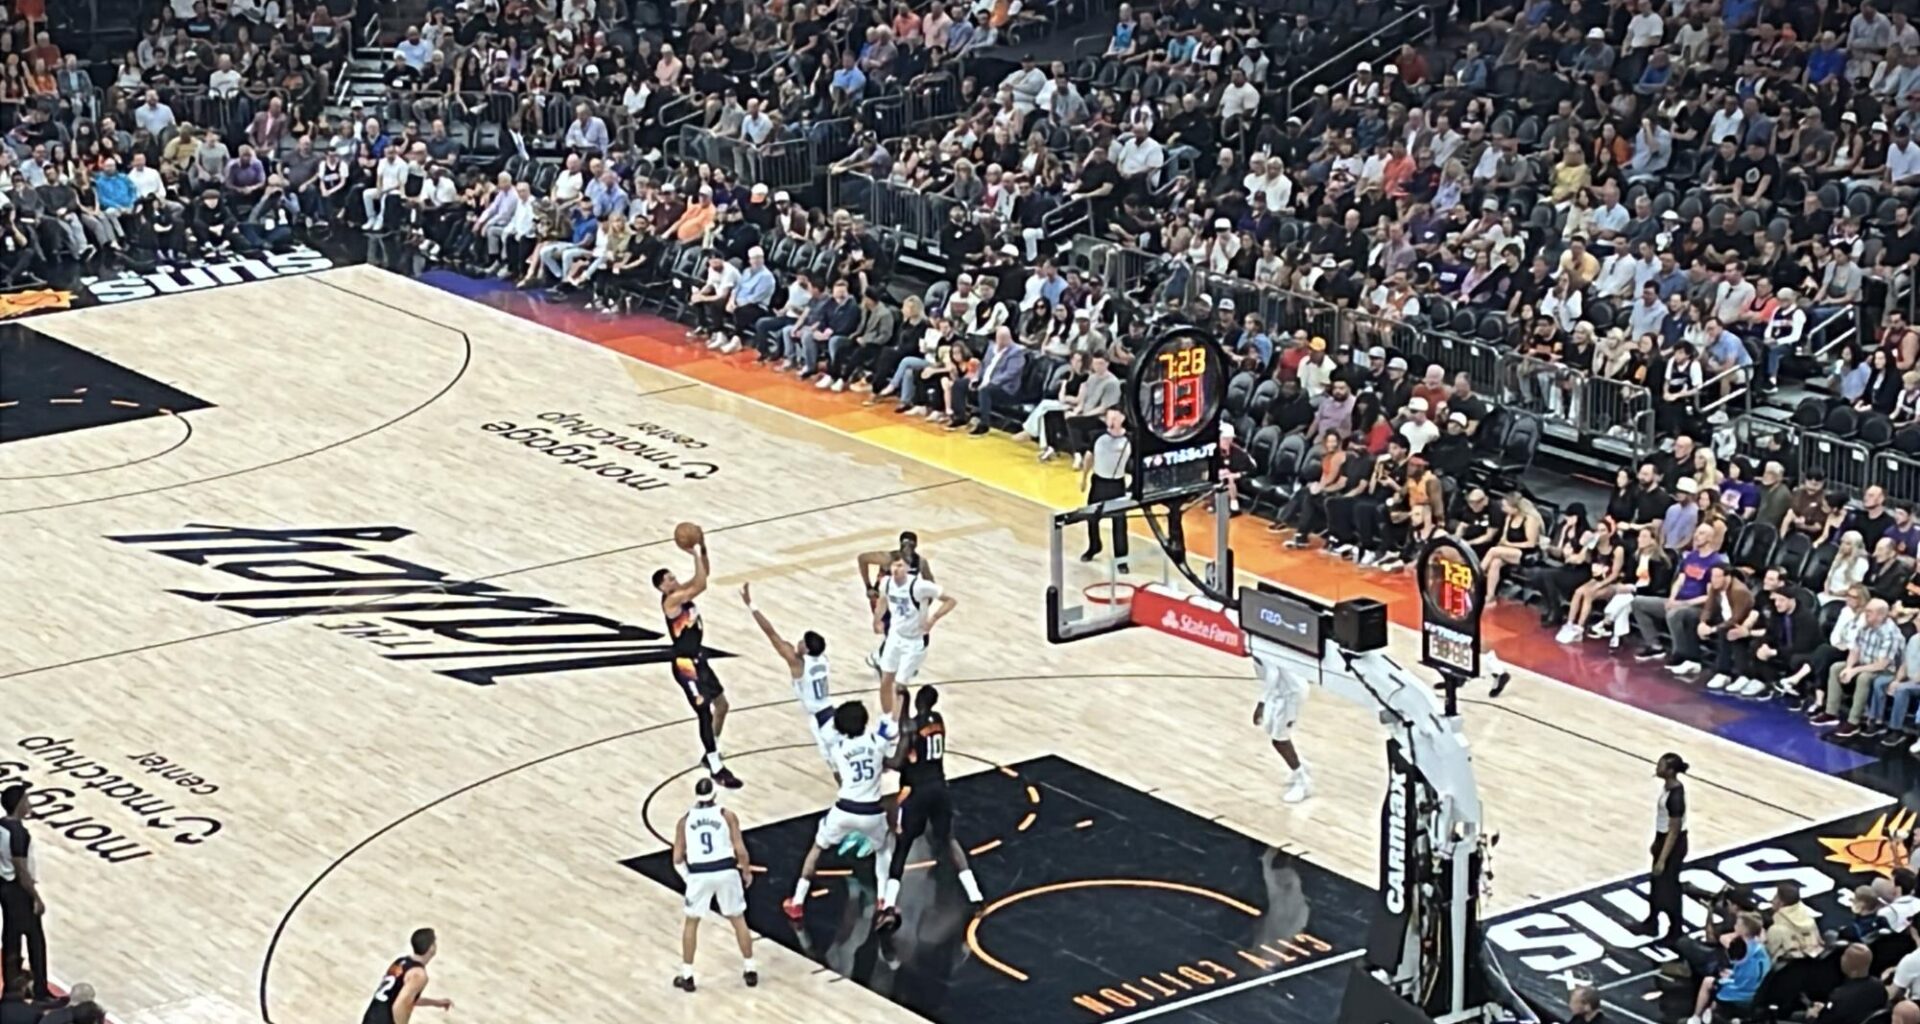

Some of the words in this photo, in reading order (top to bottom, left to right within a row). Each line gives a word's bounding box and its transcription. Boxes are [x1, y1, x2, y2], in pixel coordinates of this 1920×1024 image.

[1159, 347, 1206, 379] 7:28
[1164, 377, 1203, 428] 13
[536, 411, 679, 462] matchup
[627, 421, 708, 449] center
[481, 421, 670, 491] mortgage
[1440, 559, 1472, 590] 7:28
[313, 616, 434, 649] THE
[926, 733, 943, 761] 10
[17, 736, 176, 815] matchup
[126, 752, 220, 795] center
[849, 758, 875, 783] 35
[700, 831, 714, 855] 9
[1237, 933, 1332, 971] CITY
[1073, 959, 1237, 1015] EDITION
